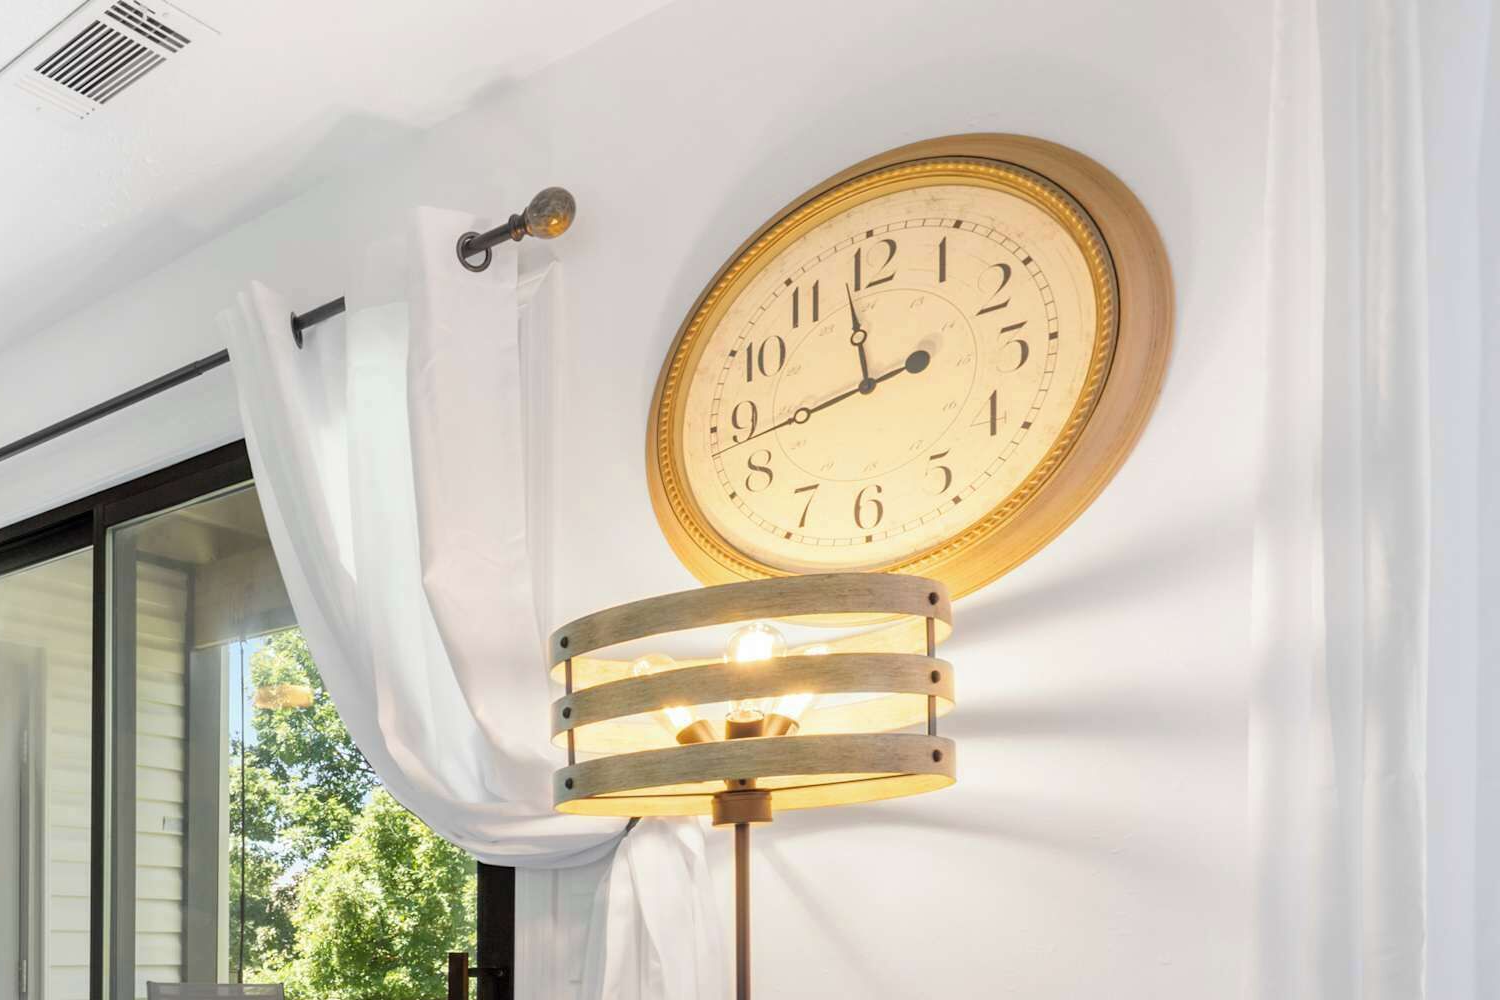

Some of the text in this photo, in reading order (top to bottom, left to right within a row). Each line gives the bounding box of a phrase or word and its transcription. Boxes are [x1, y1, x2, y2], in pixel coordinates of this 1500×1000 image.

[854, 239, 897, 292] 12
[938, 235, 947, 283] 1
[792, 279, 819, 329] 11
[975, 262, 1012, 316] 2
[746, 335, 786, 382] 10
[997, 320, 1029, 373] 3
[731, 400, 758, 444] 9
[969, 389, 1007, 436] 4
[745, 449, 773, 492] 8
[925, 449, 952, 495] 5
[794, 483, 820, 528] 7
[854, 484, 883, 530] 6
